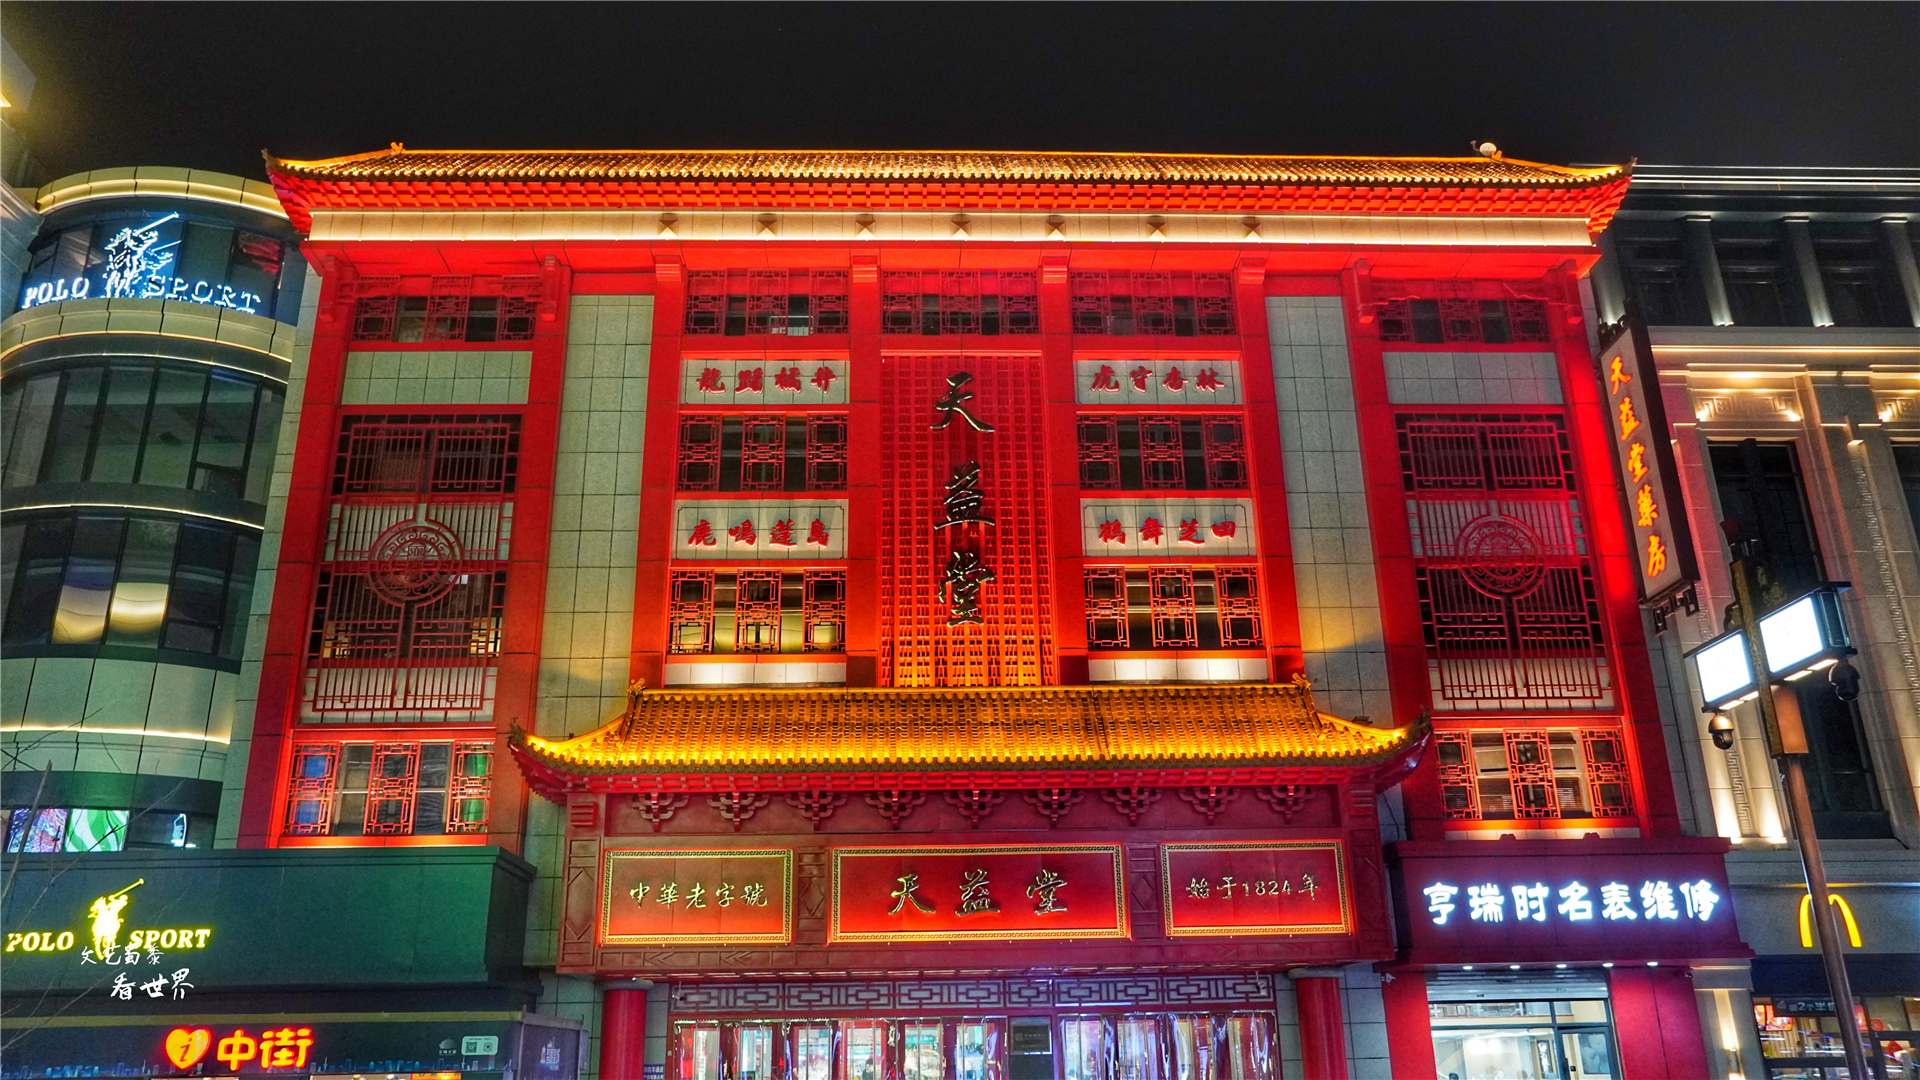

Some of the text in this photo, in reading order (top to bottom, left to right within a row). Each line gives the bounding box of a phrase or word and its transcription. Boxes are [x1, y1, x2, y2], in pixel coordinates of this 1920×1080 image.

[21, 275, 261, 312] POLO SPORT
[1091, 365, 1225, 392] 虎守杏林
[930, 371, 996, 627] 天益堂
[1099, 517, 1236, 547] 鶴舞芝田
[629, 882, 768, 909] 中華老字號
[888, 869, 1067, 917] 天益堂
[1423, 879, 1720, 925] 亨瑞时名表维修
[6, 929, 211, 952] POLO SPORT
[217, 1028, 313, 1071] 中街
